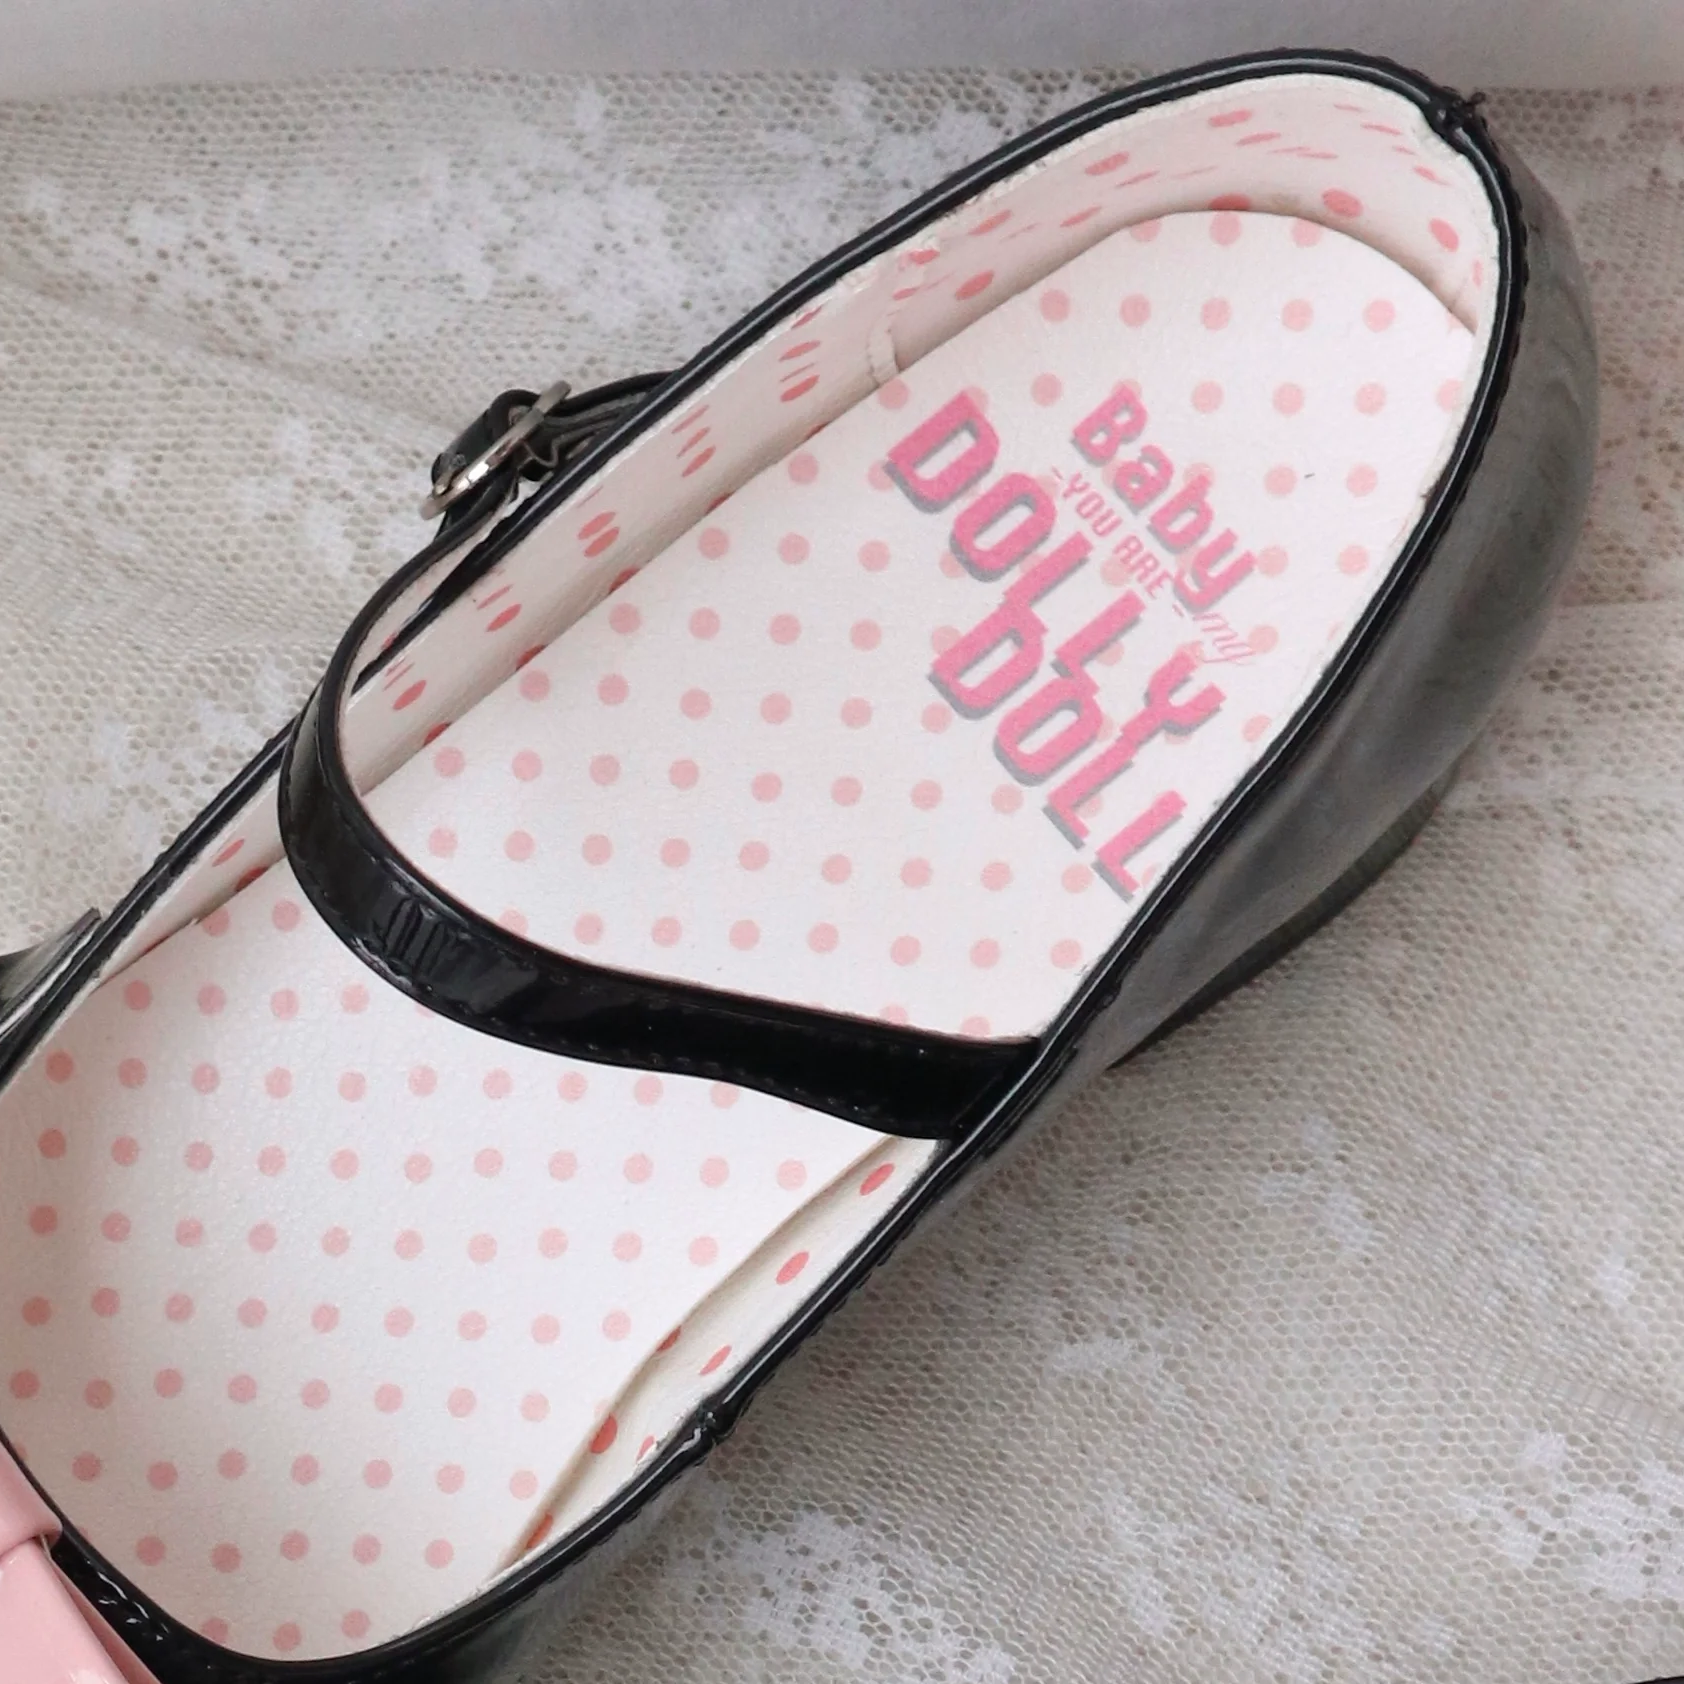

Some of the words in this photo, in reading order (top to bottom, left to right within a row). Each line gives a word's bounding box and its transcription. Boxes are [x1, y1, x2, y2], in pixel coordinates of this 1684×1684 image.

[883, 390, 1227, 742] DOLLY
[1072, 384, 1257, 613] Baby
[1112, 534, 1174, 600] ARE
